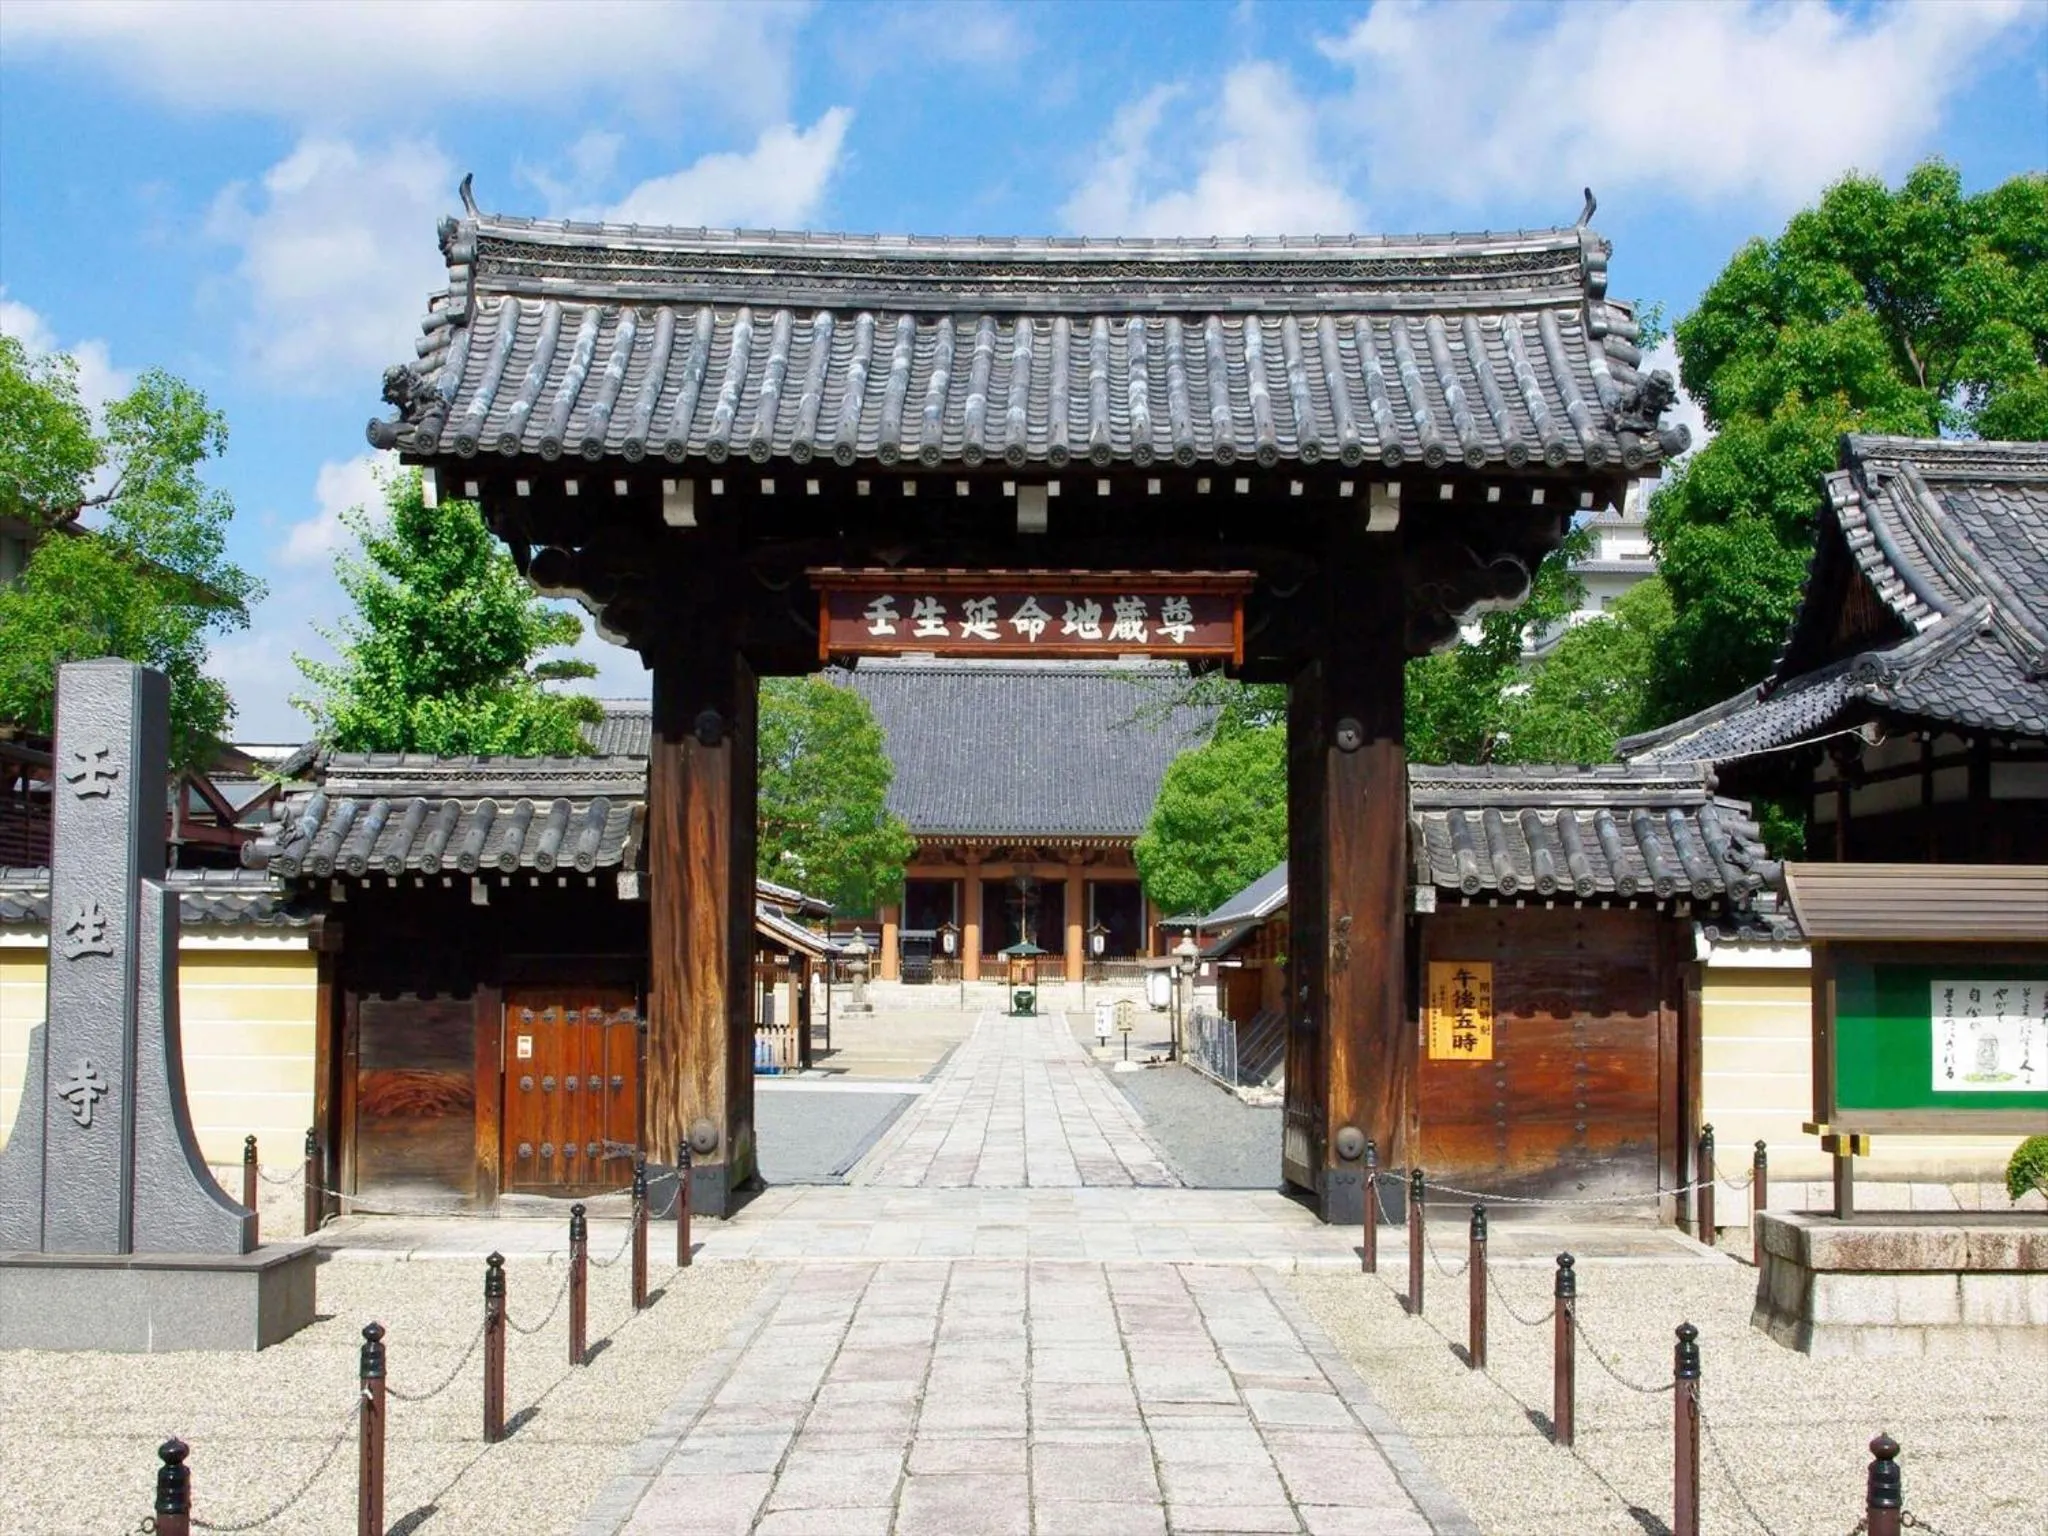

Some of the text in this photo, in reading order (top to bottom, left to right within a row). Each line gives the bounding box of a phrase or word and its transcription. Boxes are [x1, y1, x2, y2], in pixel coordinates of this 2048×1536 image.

[862, 594, 1196, 644] 壬生延命地蔵尊
[58, 743, 120, 1129] 壬生寺
[1452, 968, 1478, 1053] 午後五時
